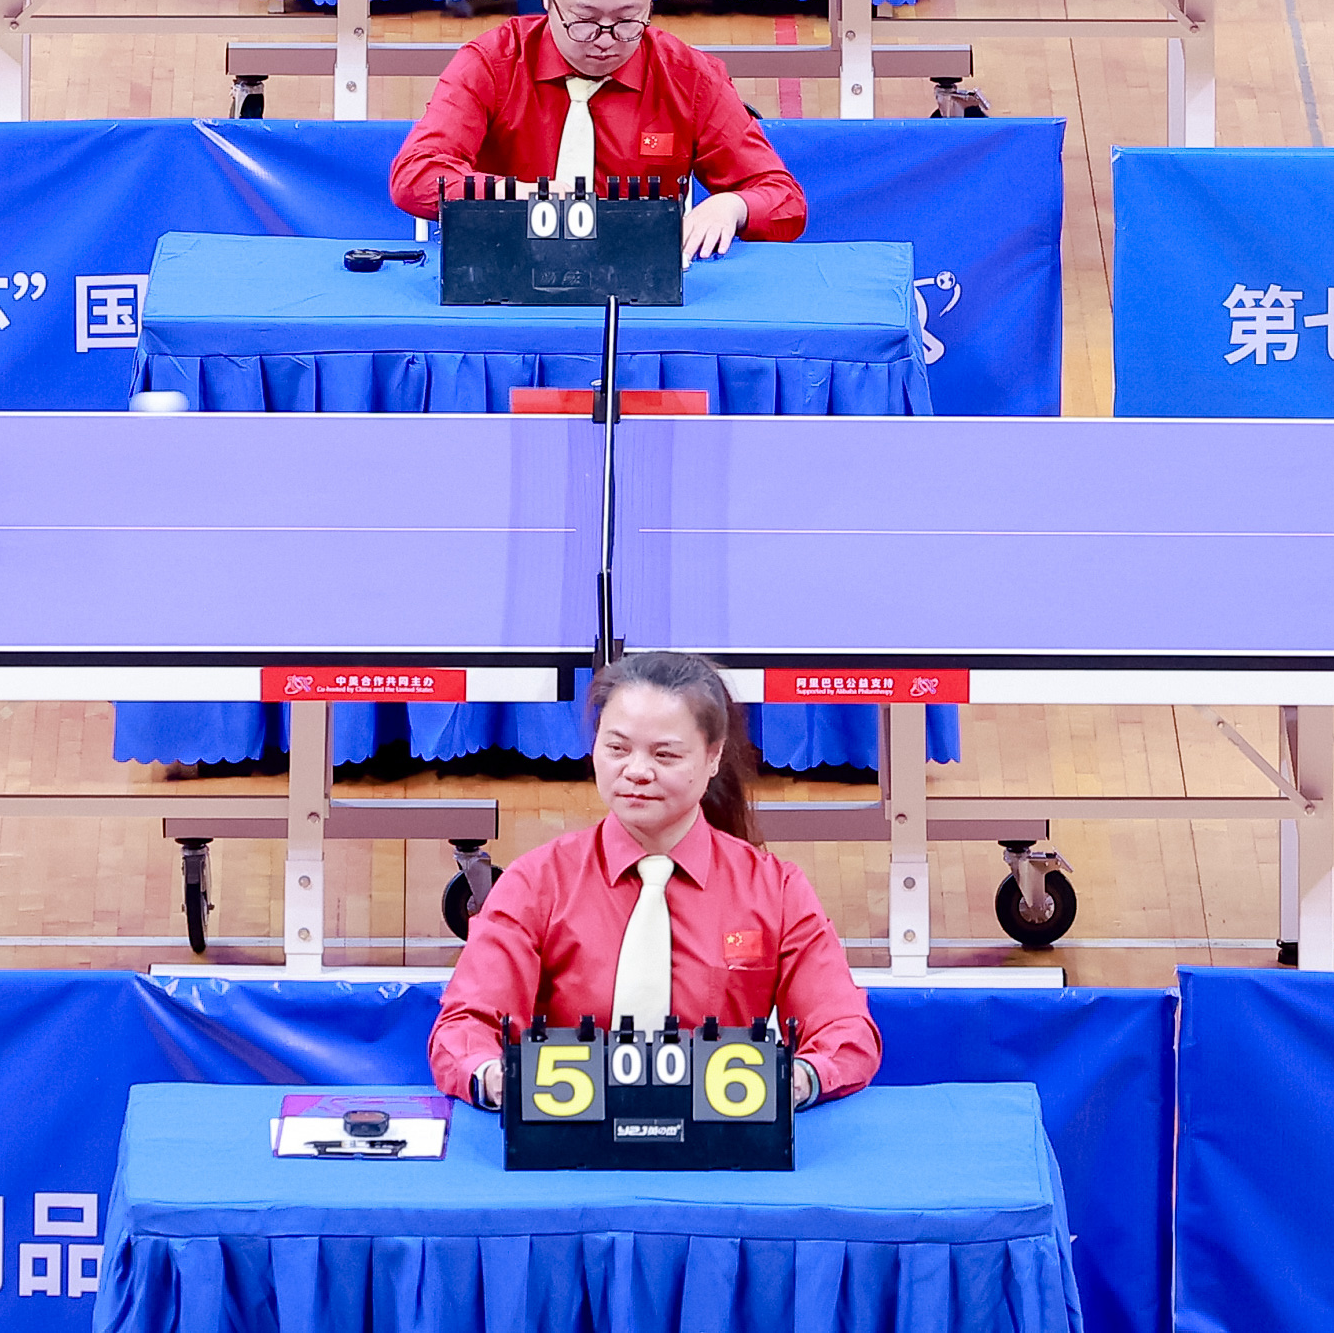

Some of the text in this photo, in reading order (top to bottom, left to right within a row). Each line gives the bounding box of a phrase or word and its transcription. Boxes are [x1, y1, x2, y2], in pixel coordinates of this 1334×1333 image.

[531, 201, 594, 237] 0 0
[335, 676, 434, 686] 中美合作共同主办
[796, 678, 894, 688] 阿里巴巴公益支持
[533, 1043, 767, 1117] 5 0 0 6
